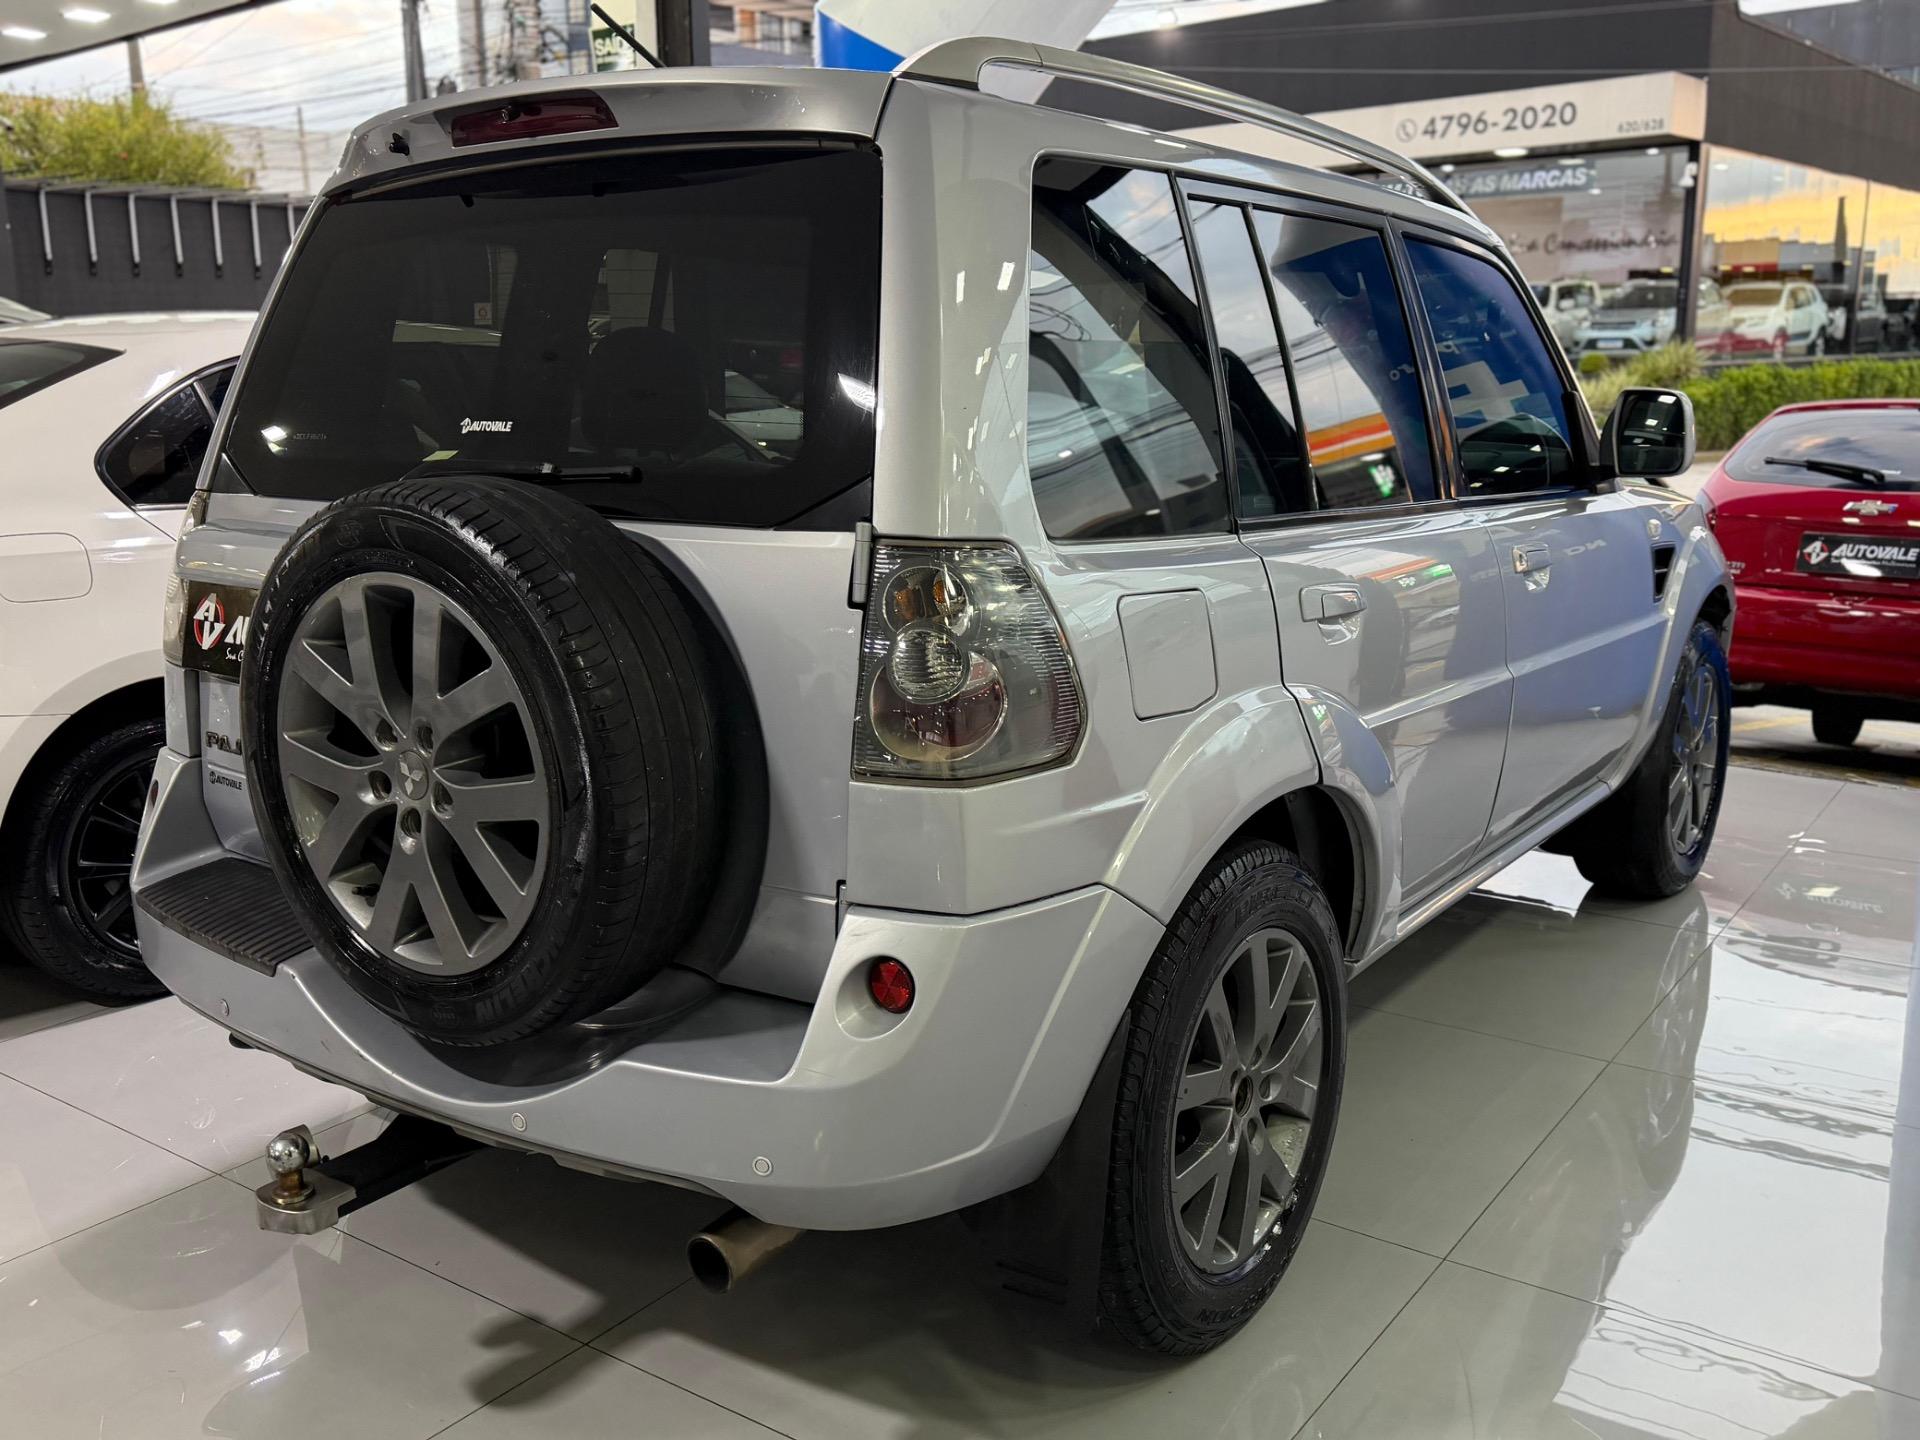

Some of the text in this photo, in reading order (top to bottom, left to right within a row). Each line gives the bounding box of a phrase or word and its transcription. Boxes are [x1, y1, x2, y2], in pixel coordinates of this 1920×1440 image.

[1421, 101, 1578, 141] 4796-2020
[1501, 167, 1588, 192] MARCAS
[469, 420, 514, 432] AUTOVALE
[1831, 542, 1920, 562] AUTOVALE
